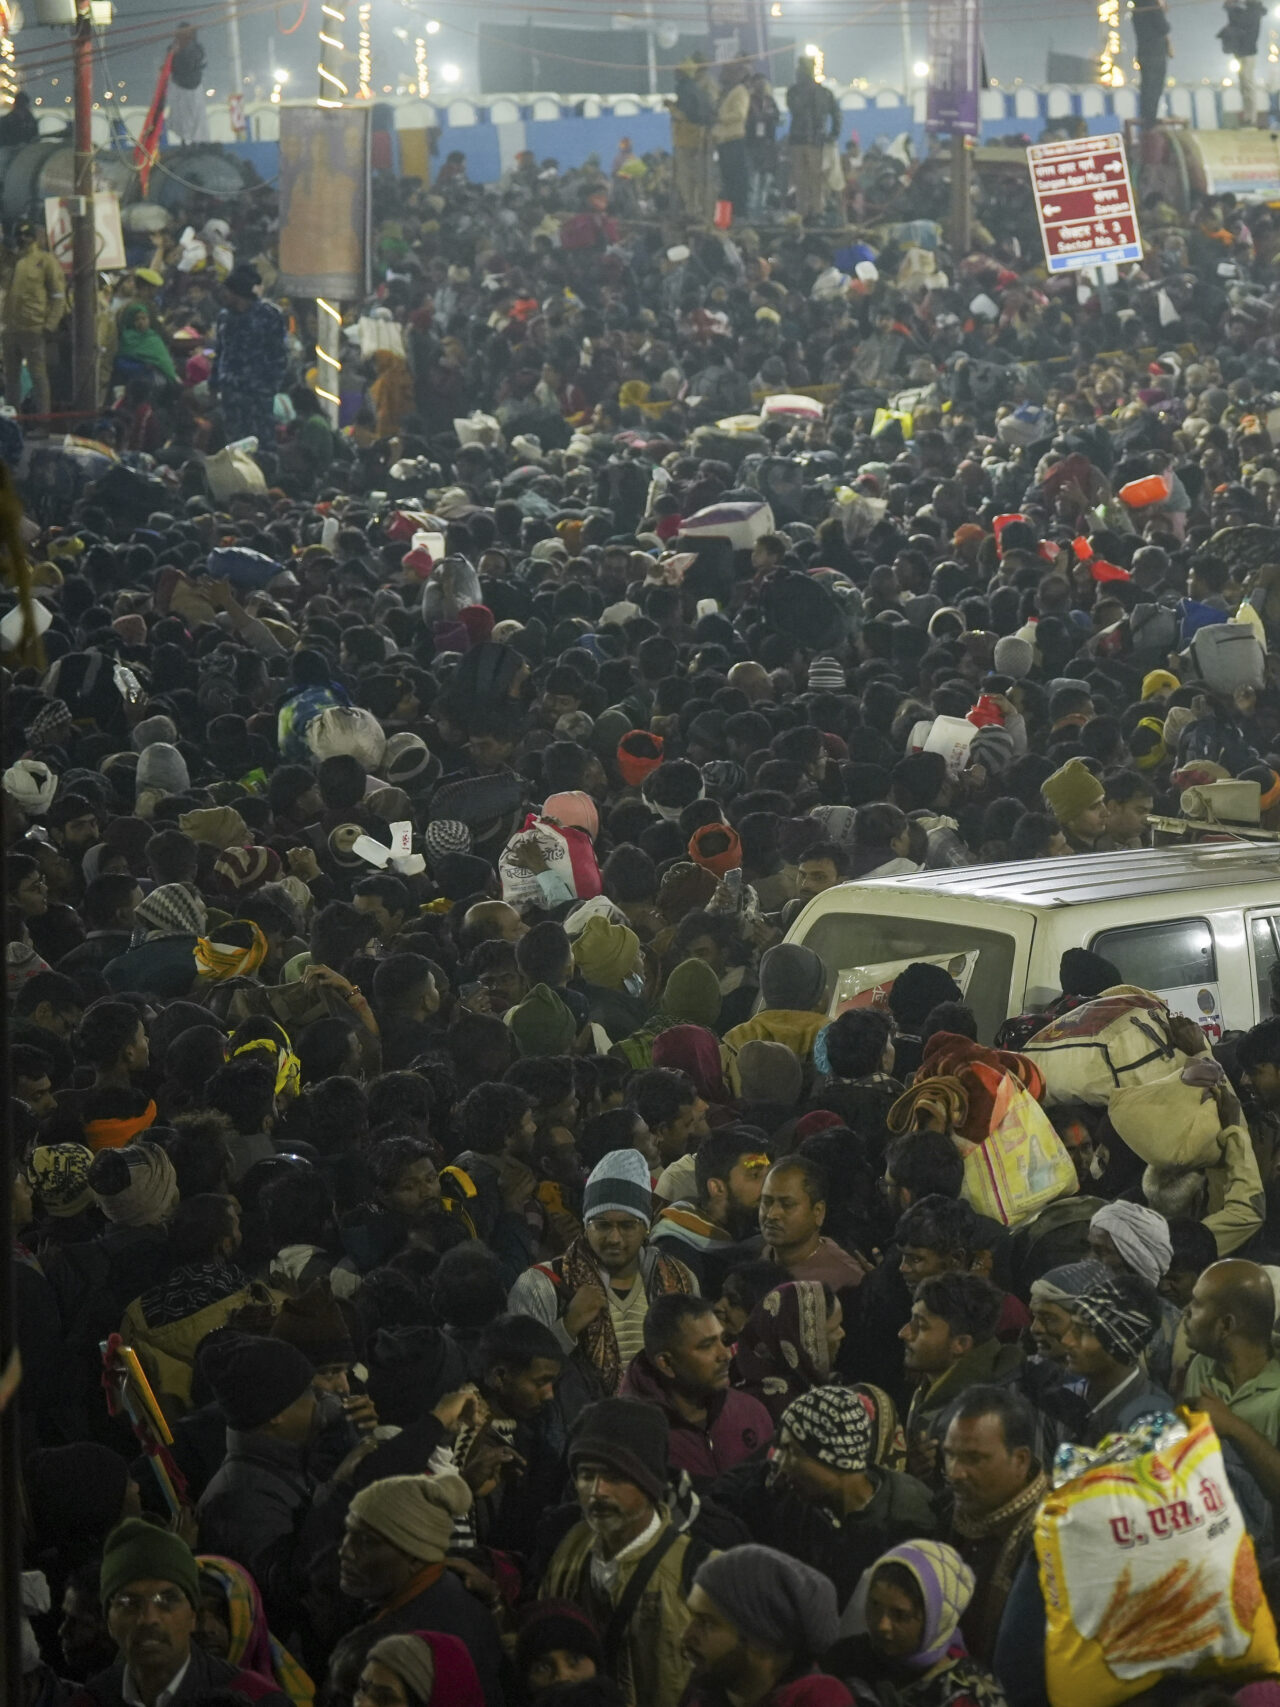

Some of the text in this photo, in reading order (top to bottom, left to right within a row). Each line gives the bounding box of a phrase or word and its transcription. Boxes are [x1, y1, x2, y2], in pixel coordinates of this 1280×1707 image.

[1036, 163, 1056, 177] संगम
[1092, 188, 1119, 201] संगम
[1094, 201, 1130, 215] Sangam
[1058, 225, 1091, 240] सेक्टर
[1111, 220, 1122, 233] 3
[1056, 233, 1128, 253] Sector No. 3
[1147, 1499, 1202, 1537] एस.
